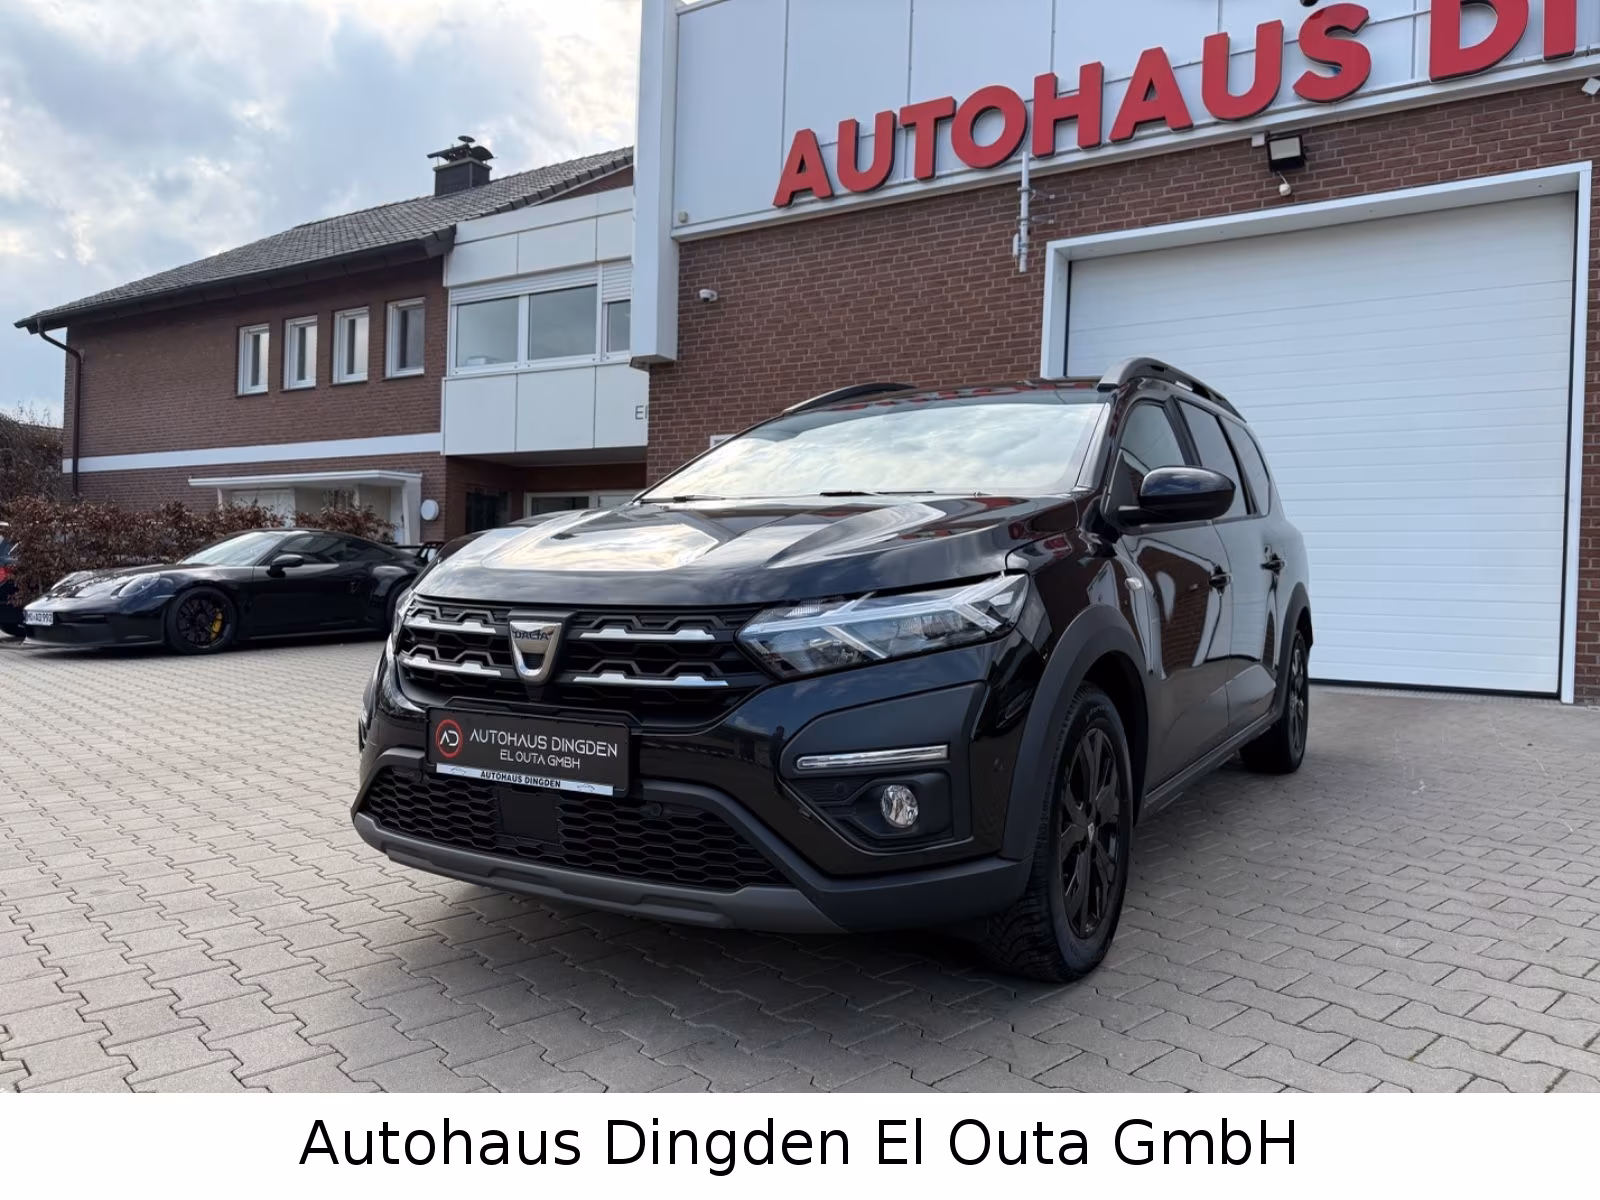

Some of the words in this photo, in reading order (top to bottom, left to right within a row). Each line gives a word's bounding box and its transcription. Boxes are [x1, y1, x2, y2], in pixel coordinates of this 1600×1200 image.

[773, 3, 1371, 207] AUTOHAUS
[469, 728, 548, 750] AUTOHAUS
[551, 736, 618, 757] DINGDEN
[500, 748, 514, 762] EL
[515, 751, 546, 765] OUTA
[547, 754, 581, 770] GMBH
[480, 770, 523, 784] AUTOHAUS
[524, 775, 561, 788] DINGDEN
